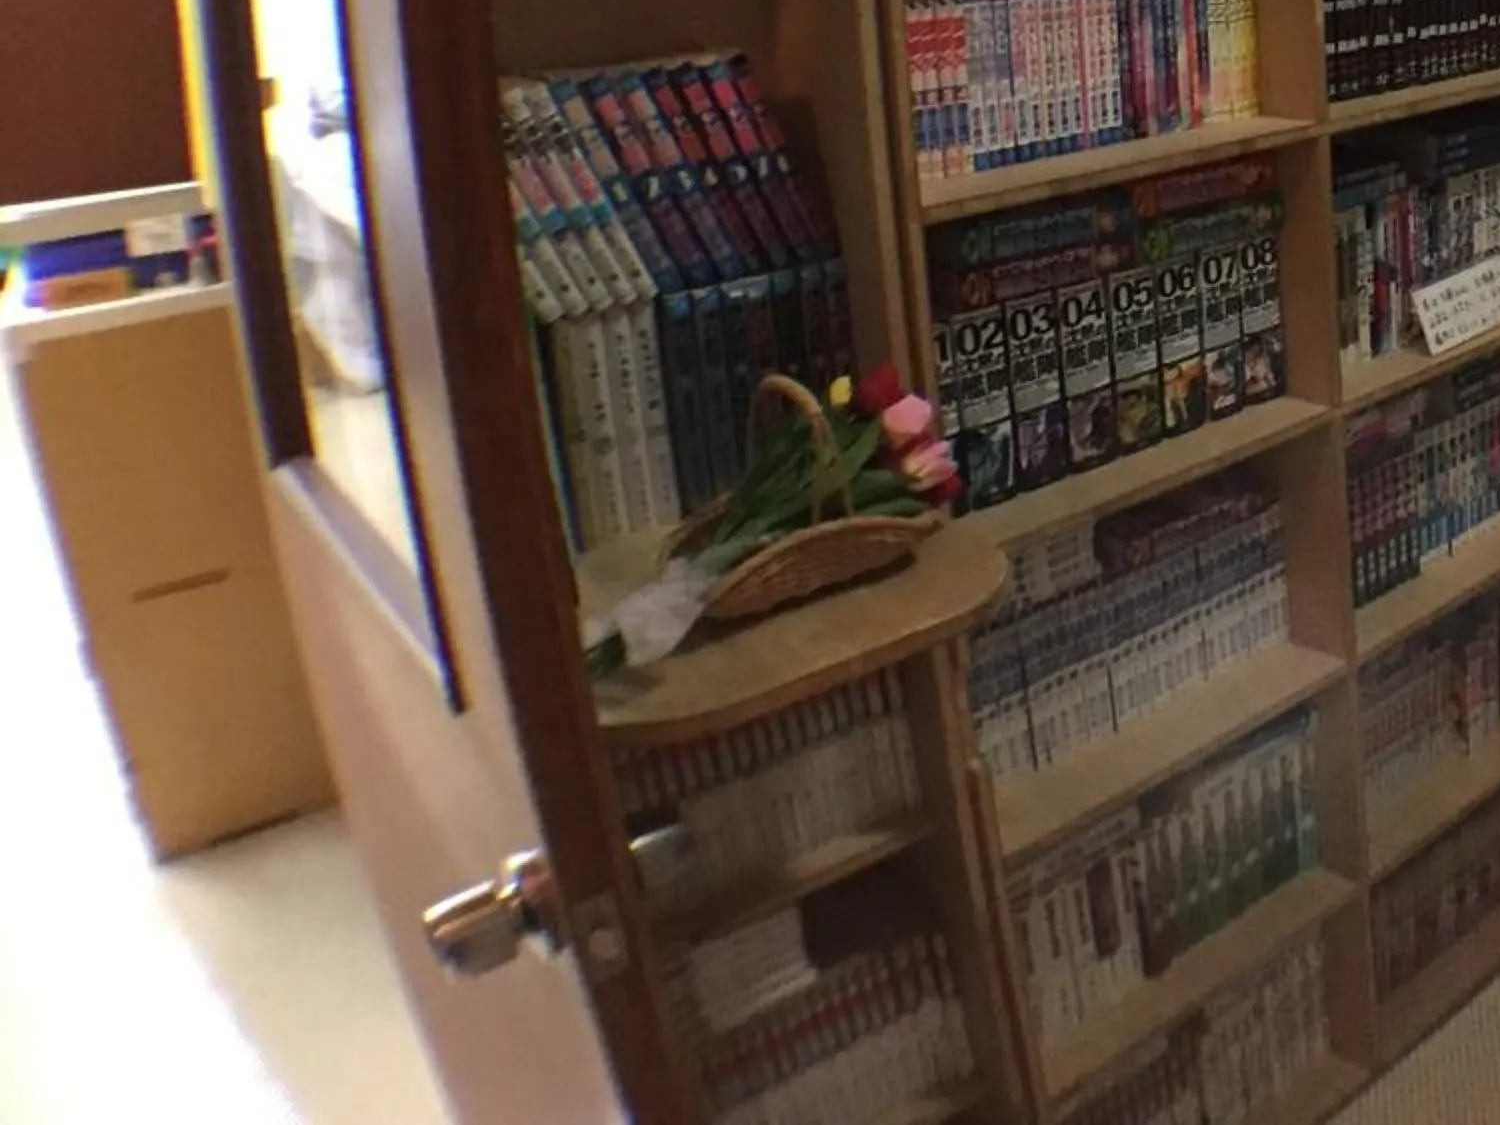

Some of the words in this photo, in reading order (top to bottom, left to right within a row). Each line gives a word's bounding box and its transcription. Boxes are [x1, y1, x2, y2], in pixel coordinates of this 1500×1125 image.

[1203, 254, 1238, 286] 07
[1241, 238, 1276, 271] 08
[1113, 276, 1154, 312] 05
[1159, 264, 1196, 298] 06
[1011, 302, 1055, 341] 03
[1061, 292, 1104, 327] 04
[957, 320, 1004, 358] 02
